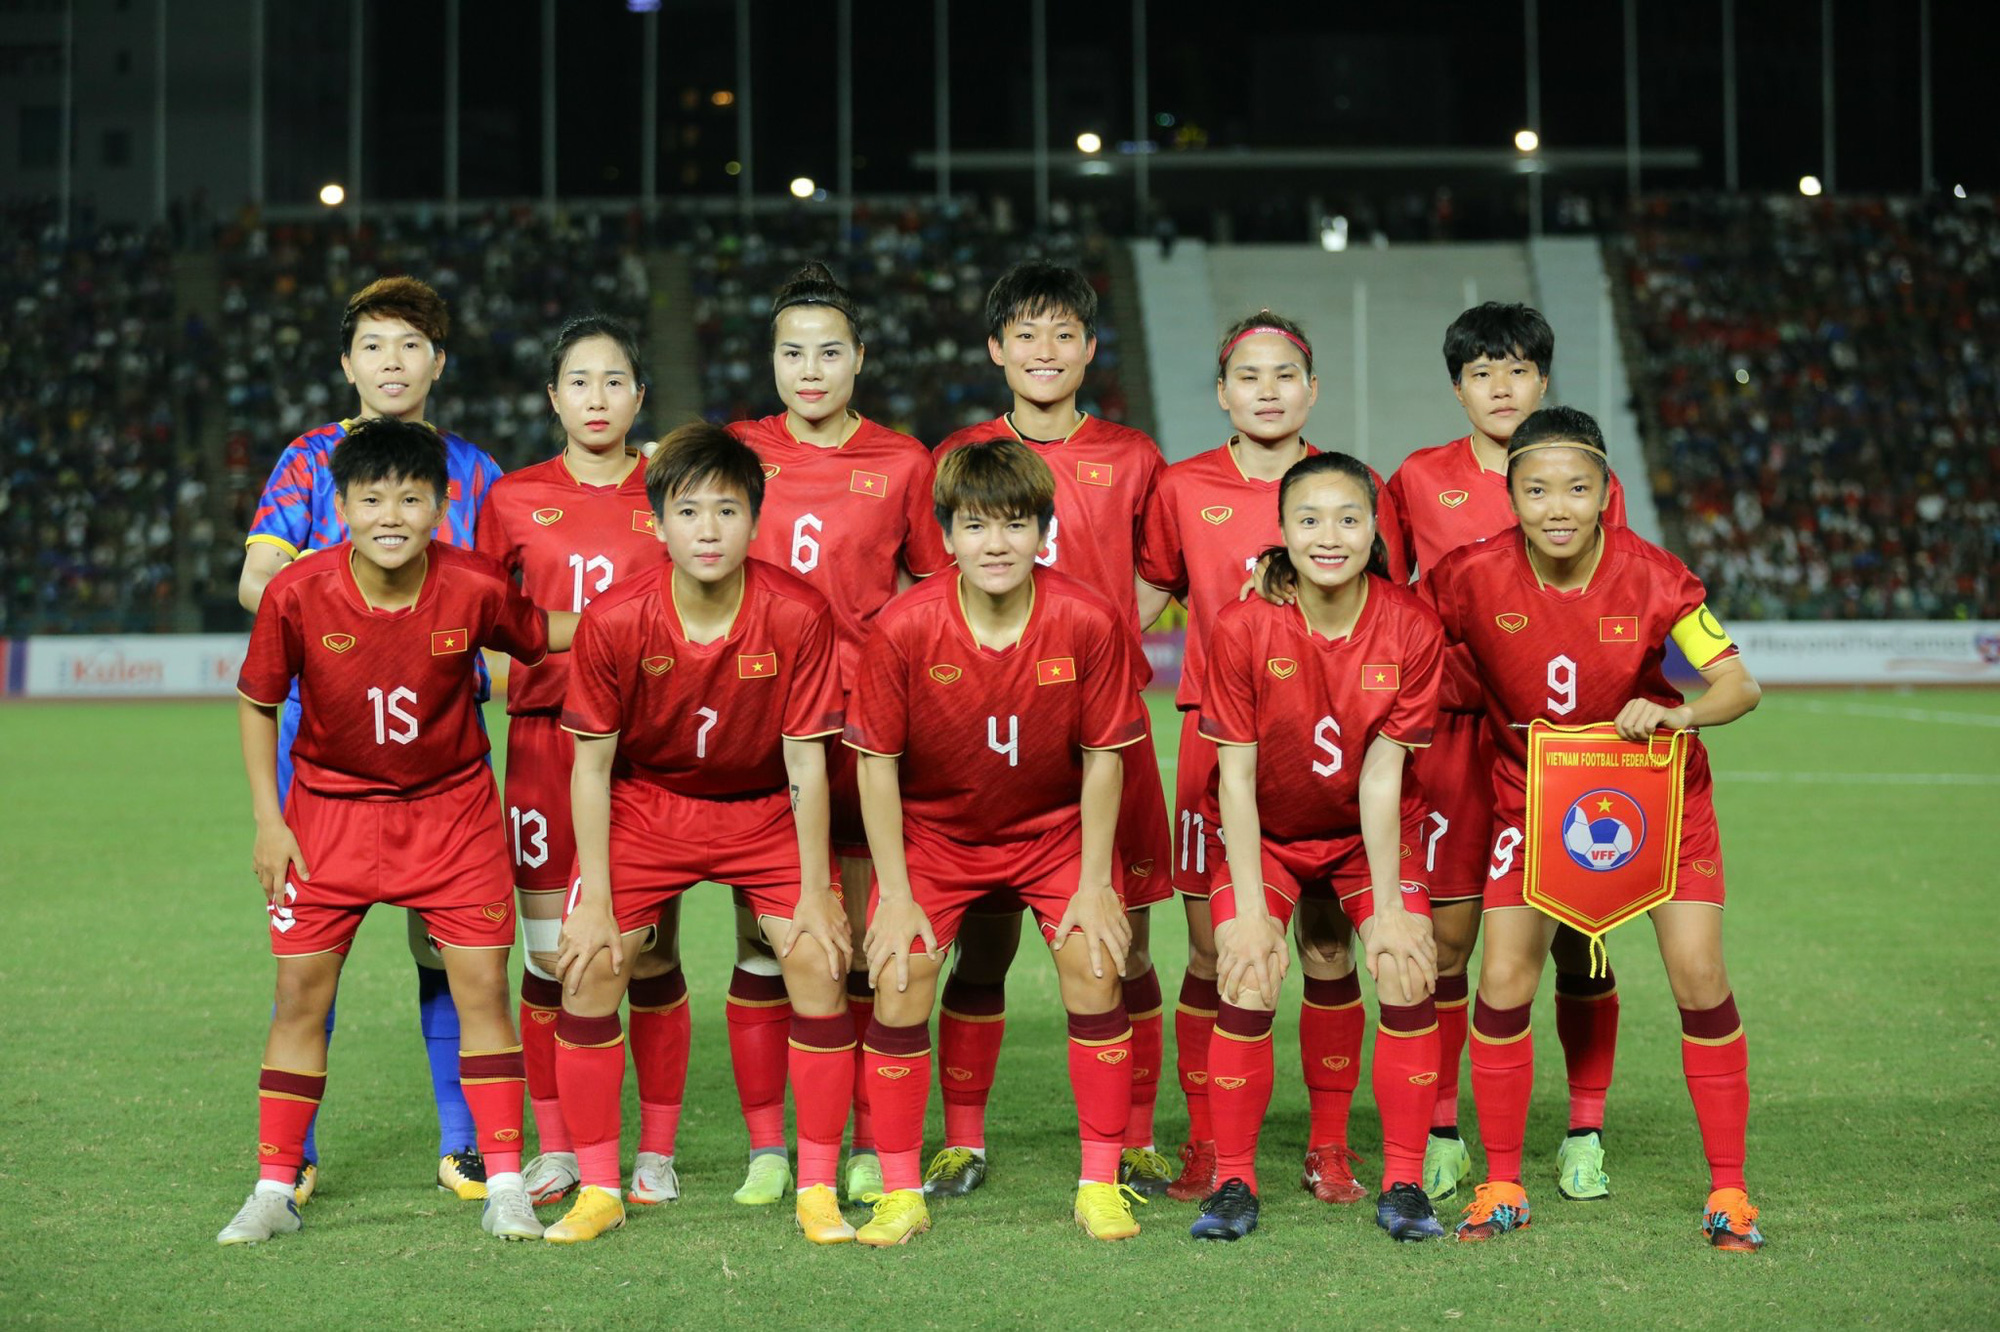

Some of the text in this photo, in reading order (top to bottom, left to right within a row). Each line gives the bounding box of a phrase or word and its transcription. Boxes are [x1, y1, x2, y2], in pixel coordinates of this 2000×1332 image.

[790, 513, 823, 574] 6
[1547, 654, 1577, 716] 9
[367, 686, 419, 746] 15
[691, 707, 718, 758] 7
[987, 715, 1018, 767] 4
[1312, 715, 1343, 777] 5
[1546, 752, 1579, 766] VIETNAM
[1581, 752, 1619, 767] FOOTBALL
[511, 806, 549, 869] 13
[1181, 809, 1205, 874] 11
[1420, 811, 1449, 872] 7
[1490, 827, 1524, 880] 9
[1591, 850, 1616, 860] VFF
